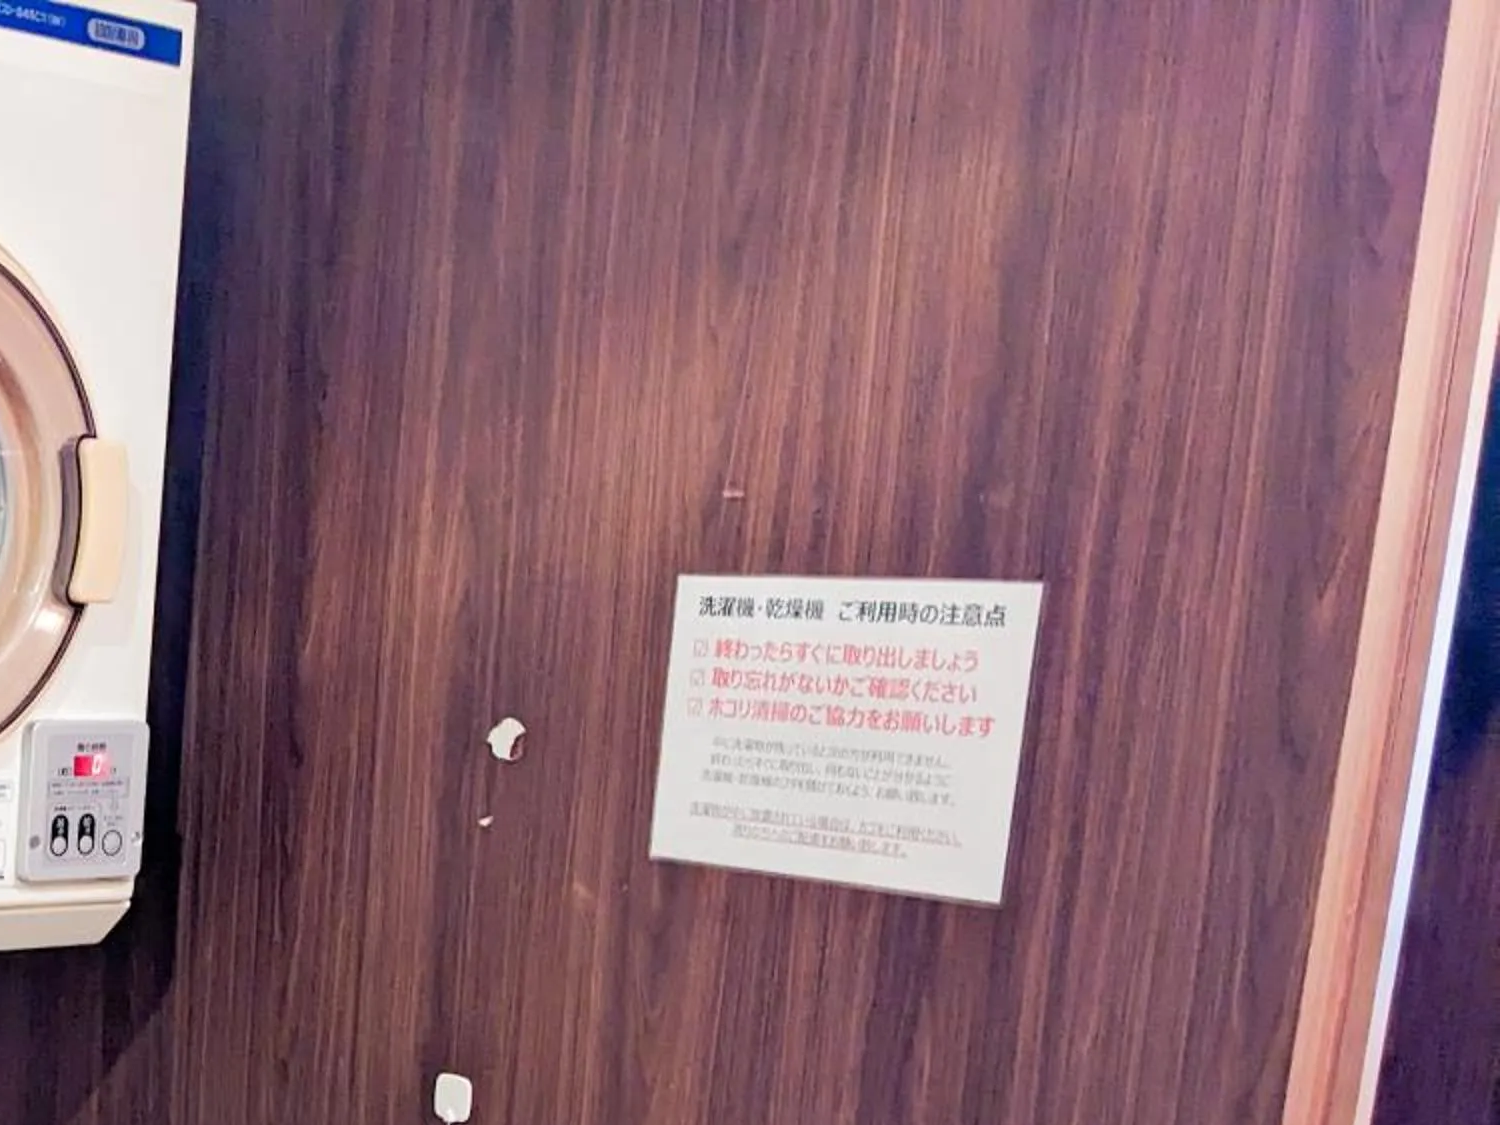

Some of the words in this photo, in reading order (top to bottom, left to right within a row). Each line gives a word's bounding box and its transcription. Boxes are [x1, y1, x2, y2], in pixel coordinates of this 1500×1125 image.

[698, 595, 825, 621] 洗濯機・乾燥機
[837, 599, 1007, 628] ご利用時の注意点
[713, 639, 979, 672] 終わったらすぐに取り出しましょう
[711, 667, 977, 703] 取り忘れがないかご確認ください
[708, 697, 996, 738] ホコリ清掃のご協力をお願いします
